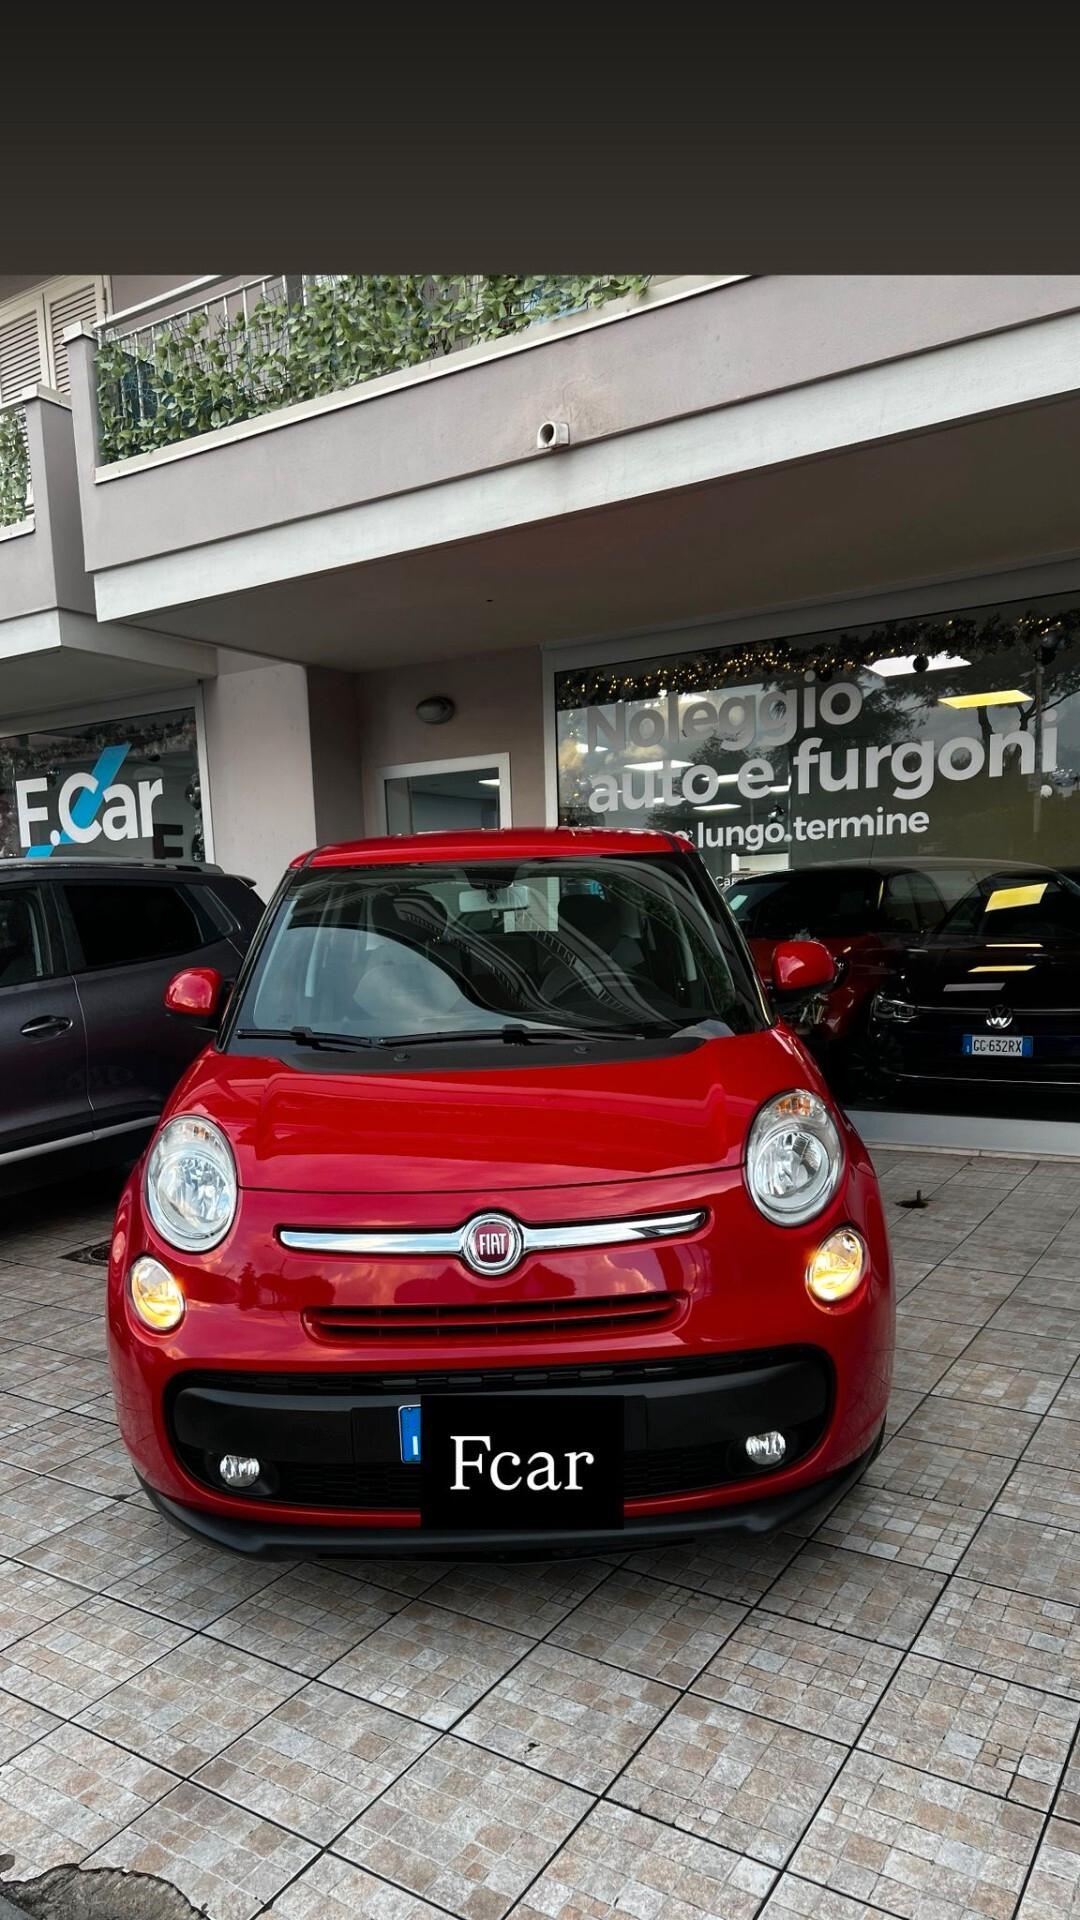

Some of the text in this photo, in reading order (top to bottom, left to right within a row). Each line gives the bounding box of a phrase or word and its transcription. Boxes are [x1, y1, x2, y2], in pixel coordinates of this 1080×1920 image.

[587, 670, 863, 751] Noleggio
[588, 708, 1058, 813] auto e furgoni
[15, 772, 163, 847] F.Car
[697, 806, 930, 851] lungo termine
[479, 1232, 507, 1255] FIAT
